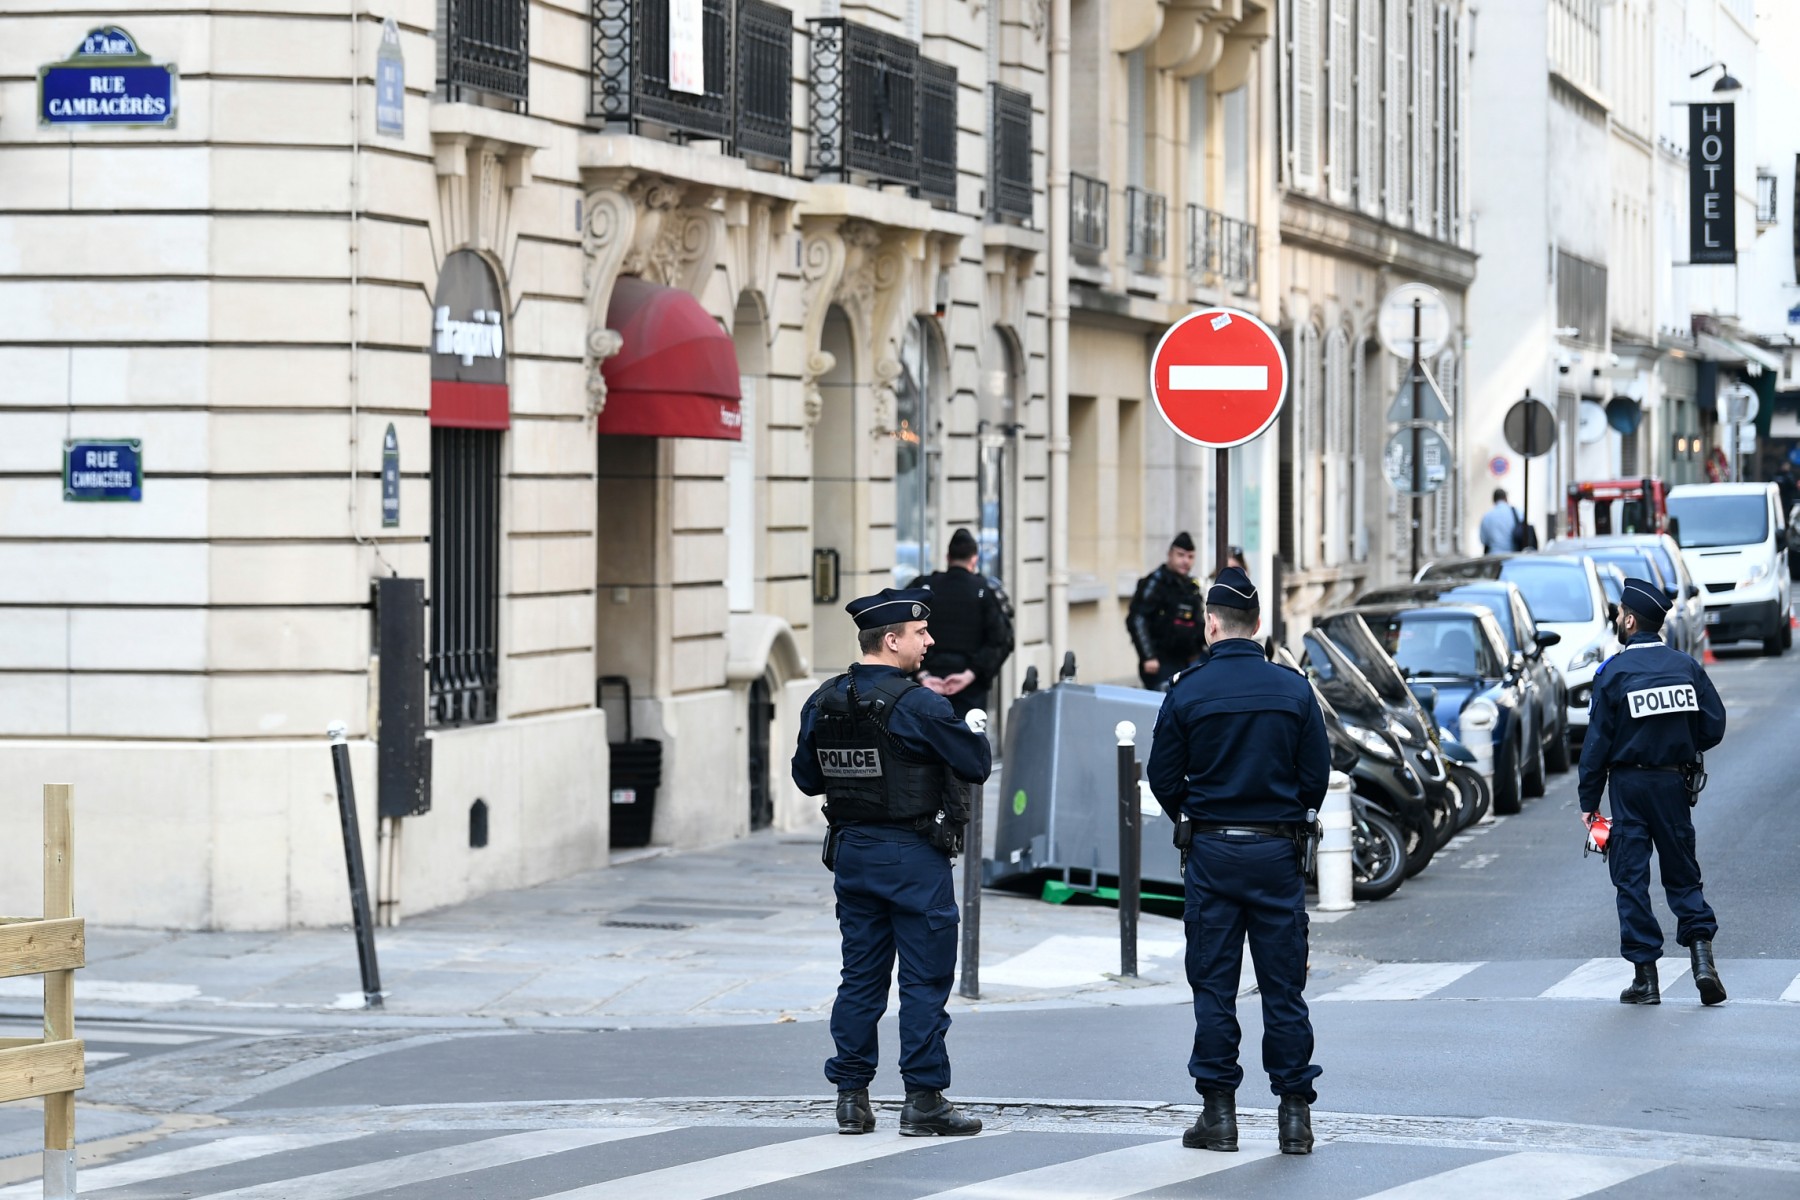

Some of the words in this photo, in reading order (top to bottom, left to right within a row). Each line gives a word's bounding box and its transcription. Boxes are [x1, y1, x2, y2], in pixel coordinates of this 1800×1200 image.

[90, 76, 126, 93] RUE
[49, 94, 166, 115] CAMBACÉRÈS
[1702, 106, 1722, 247] HOTEL
[86, 451, 118, 468] RUE
[1633, 689, 1695, 713] POLICE
[819, 750, 877, 767] POLICE
